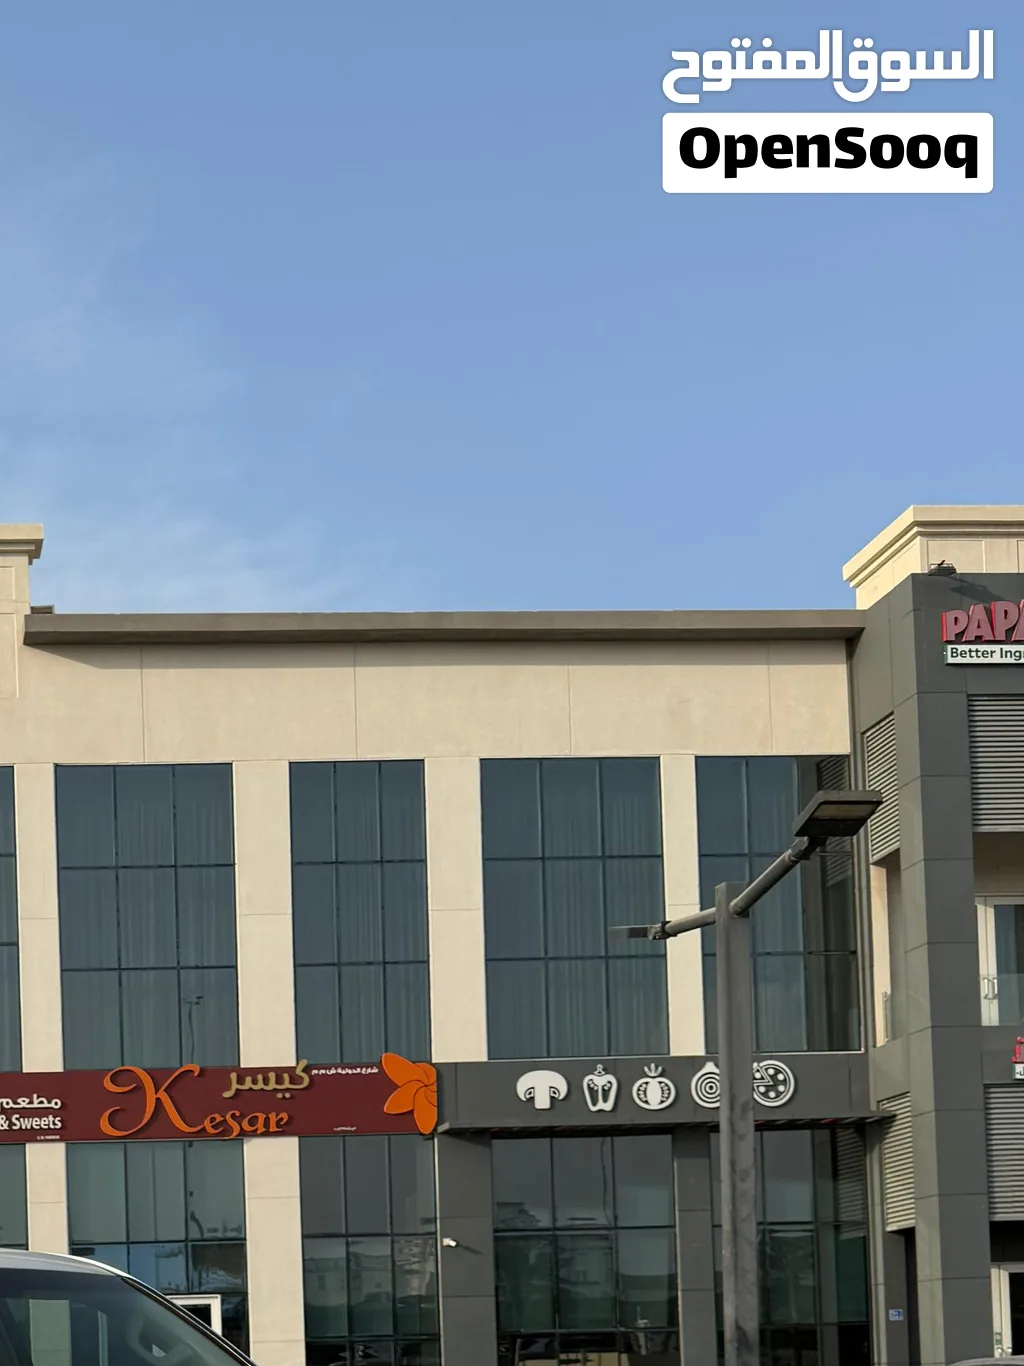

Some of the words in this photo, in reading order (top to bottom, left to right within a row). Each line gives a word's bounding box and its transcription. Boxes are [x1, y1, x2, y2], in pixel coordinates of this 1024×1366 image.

[950, 647, 996, 659] Better
[999, 647, 1024, 661] Ing
[222, 1058, 310, 1099] كيسر
[100, 1063, 289, 1140] Kesar
[11, 1114, 62, 1130] Sweets
